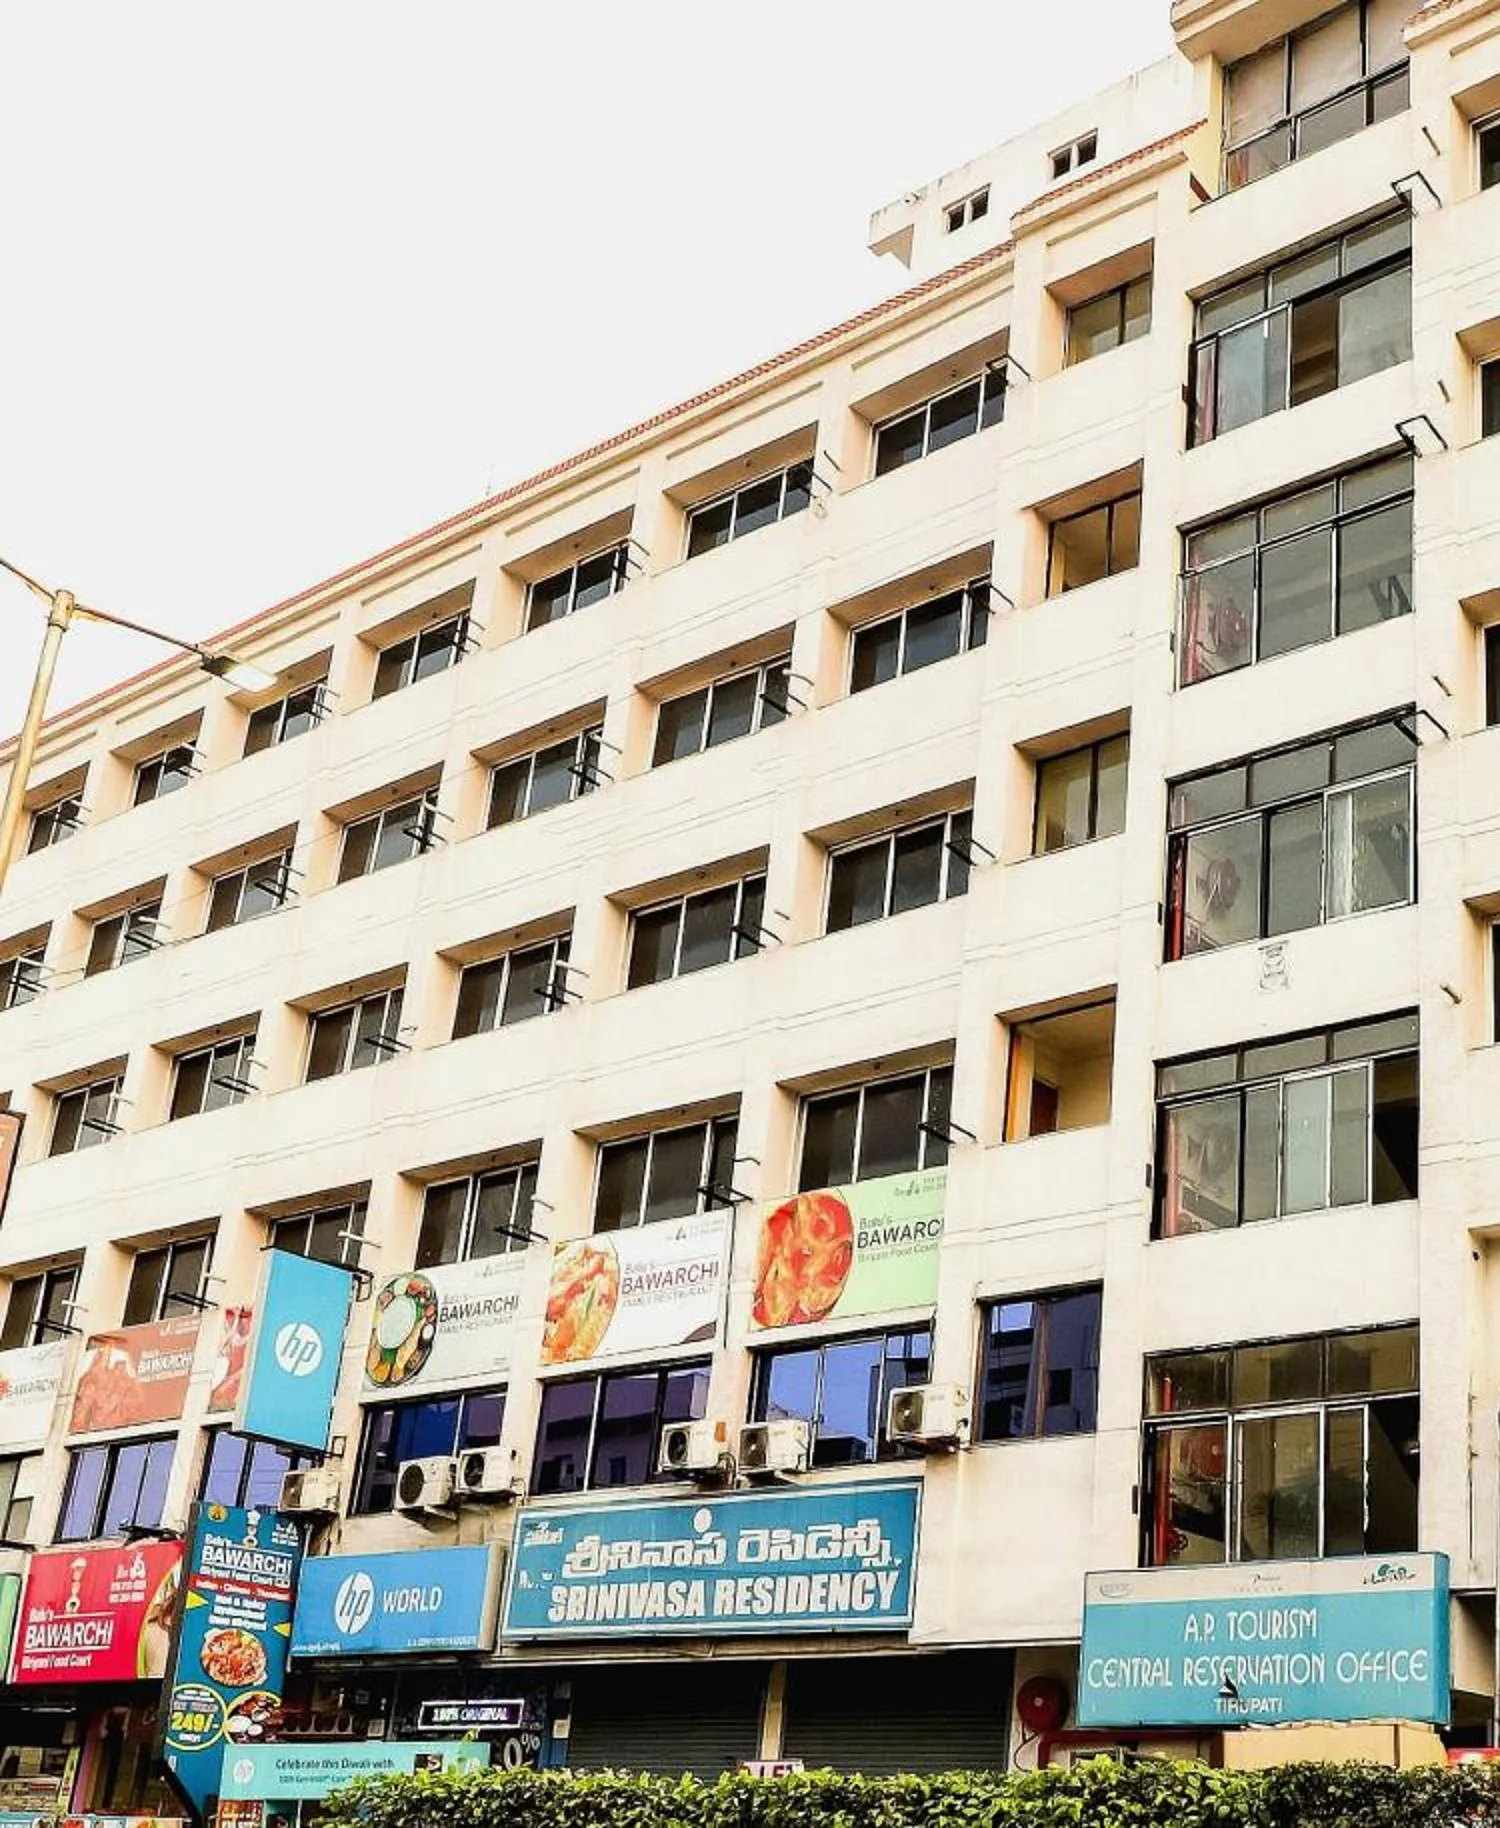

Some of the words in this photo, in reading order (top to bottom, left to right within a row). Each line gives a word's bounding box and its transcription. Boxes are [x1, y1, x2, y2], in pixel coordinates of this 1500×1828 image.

[622, 1261, 719, 1295] BAWARCHI
[439, 1295, 520, 1323] BAWARCHI
[280, 1324, 319, 1376] hp
[202, 1545, 293, 1576] BAWARCHI
[382, 1586, 443, 1613] WORLD
[548, 1579, 706, 1622] SRINIVASA
[713, 1570, 901, 1616] RESIDENCY
[24, 1619, 115, 1649] BAWARCHI
[1183, 1613, 1216, 1642] A.P.
[1227, 1608, 1318, 1642] TOURISM
[1087, 1655, 1173, 1689] CENTRAL
[1183, 1651, 1326, 1687] RESERVATION
[1336, 1648, 1430, 1683] OFFICE
[1214, 1696, 1283, 1714] TIRUPATI
[276, 1759, 319, 1769] Celebrate
[321, 1758, 339, 1769] this
[341, 1757, 371, 1769] Diwali
